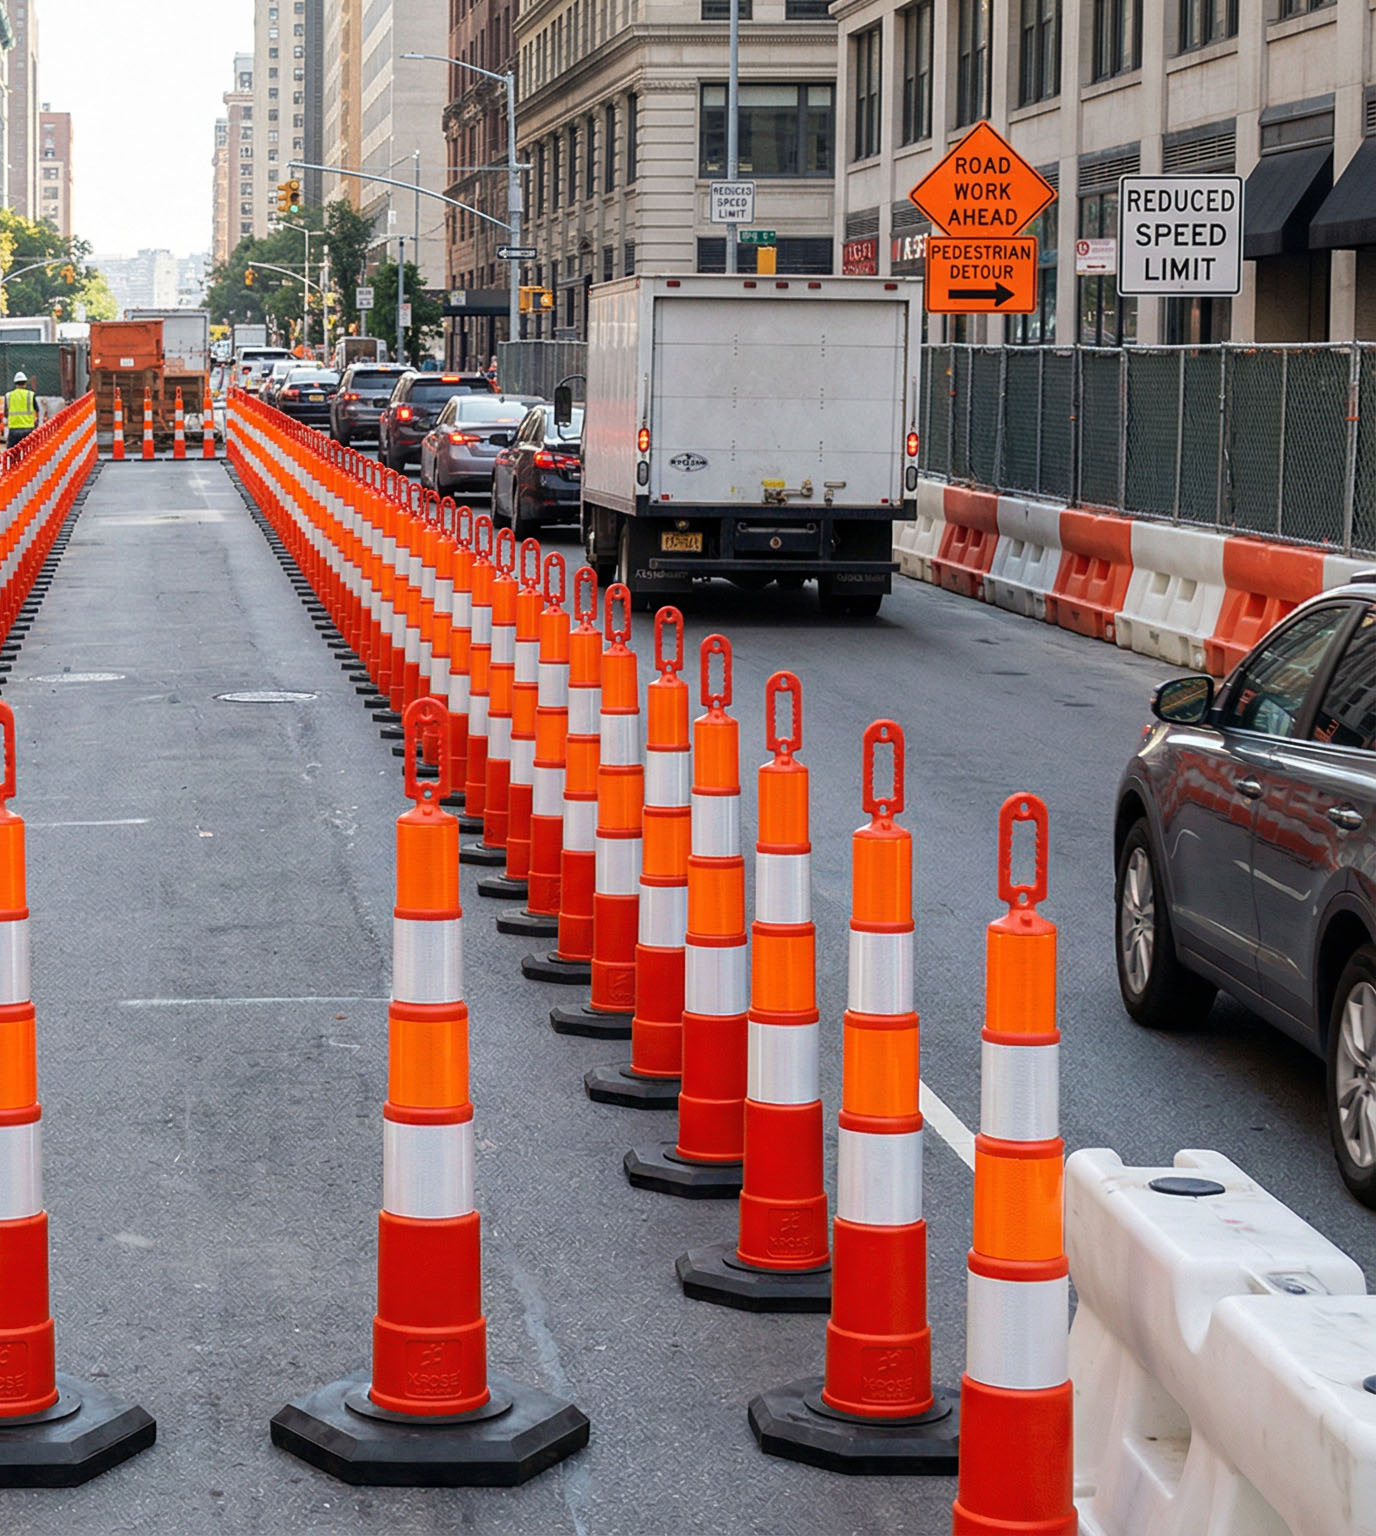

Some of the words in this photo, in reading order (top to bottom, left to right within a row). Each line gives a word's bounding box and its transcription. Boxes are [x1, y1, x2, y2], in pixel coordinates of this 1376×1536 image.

[954, 156, 1012, 175] ROAD
[954, 182, 1012, 201] WORK
[1127, 189, 1235, 213] REDUCED
[947, 208, 1019, 227] AHEAD
[1135, 222, 1227, 247] SPEED
[931, 244, 1031, 260] PEDESTRIAN
[950, 264, 1014, 280] DETOUR
[1144, 257, 1217, 281] LIMIT
